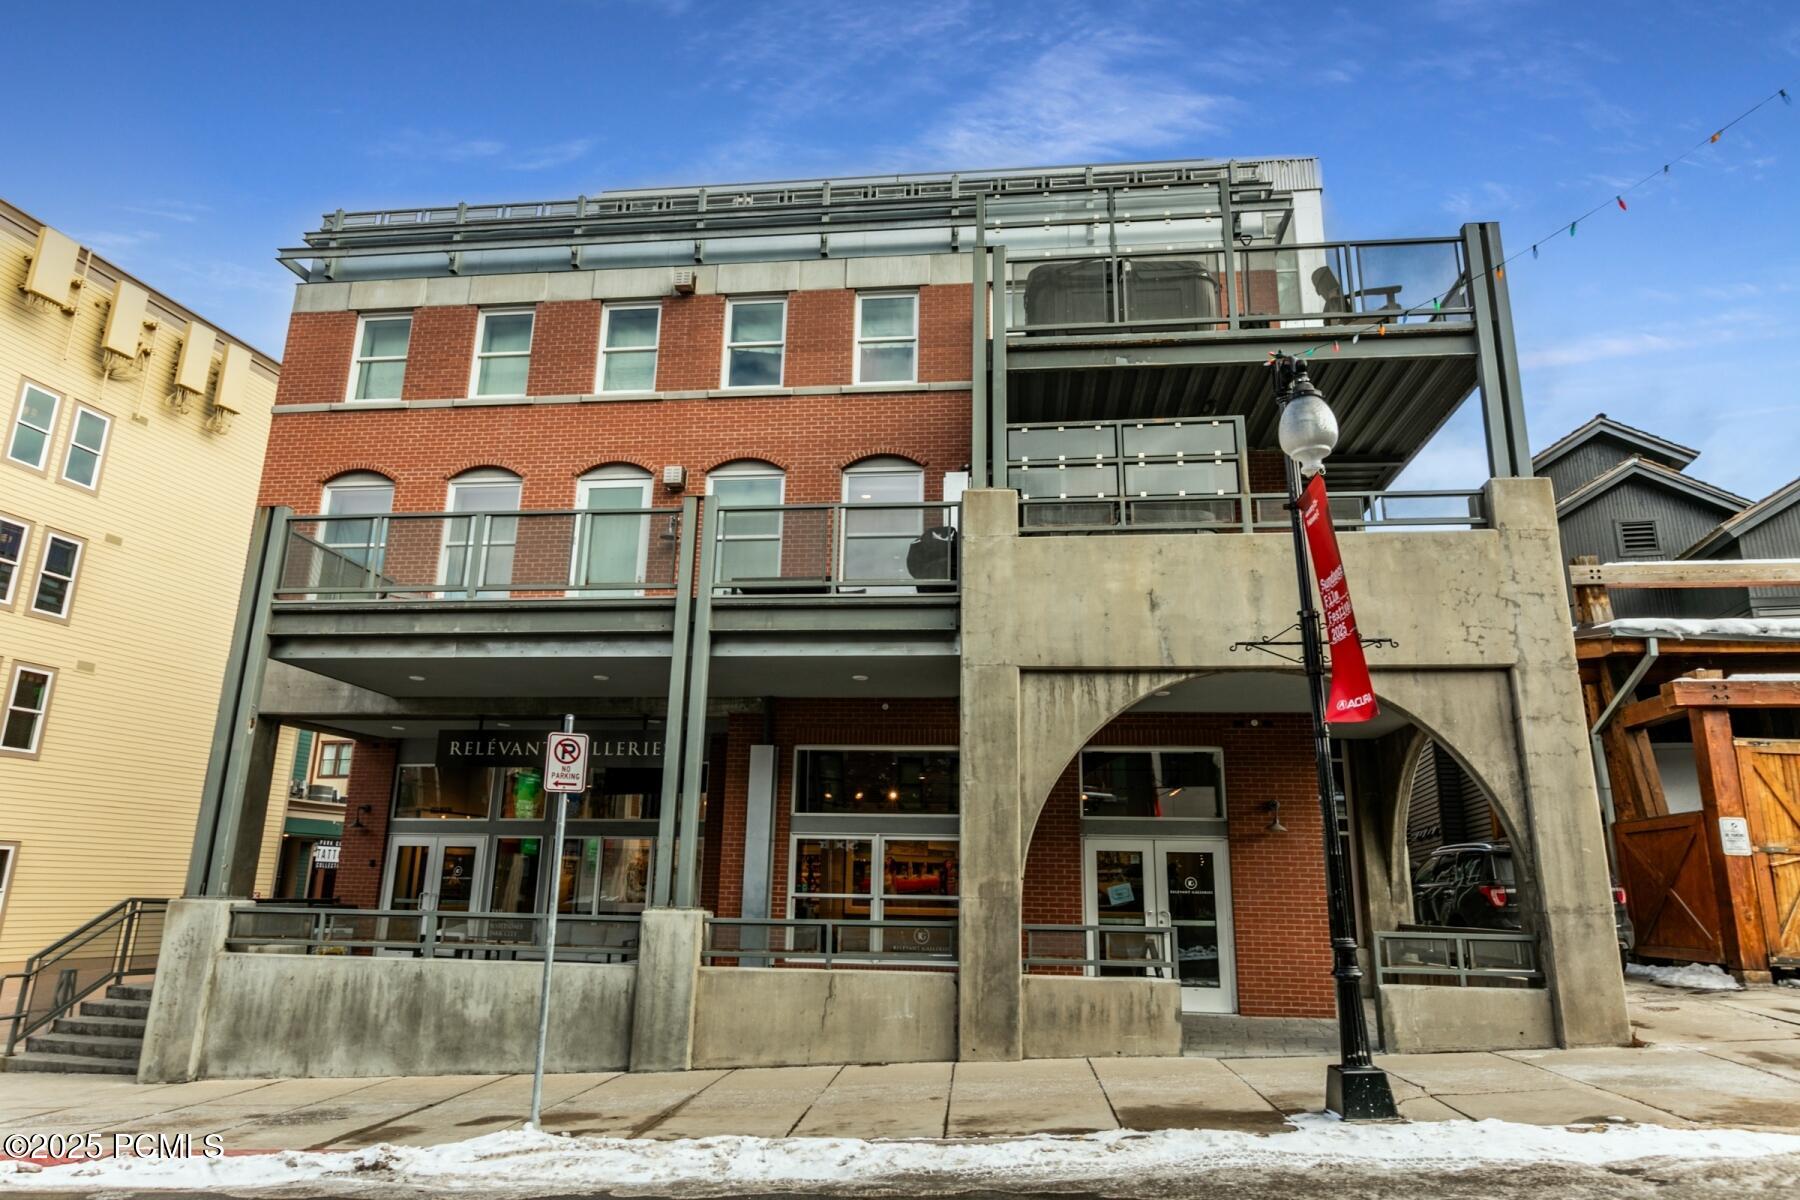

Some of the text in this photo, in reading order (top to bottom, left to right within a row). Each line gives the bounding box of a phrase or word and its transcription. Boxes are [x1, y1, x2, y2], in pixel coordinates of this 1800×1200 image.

[1331, 622, 1348, 642] 2025
[1347, 693, 1373, 709] ACURA
[450, 739, 547, 756] RELÉVAN
[551, 772, 581, 780] PARKING
[316, 849, 337, 860] TATT
